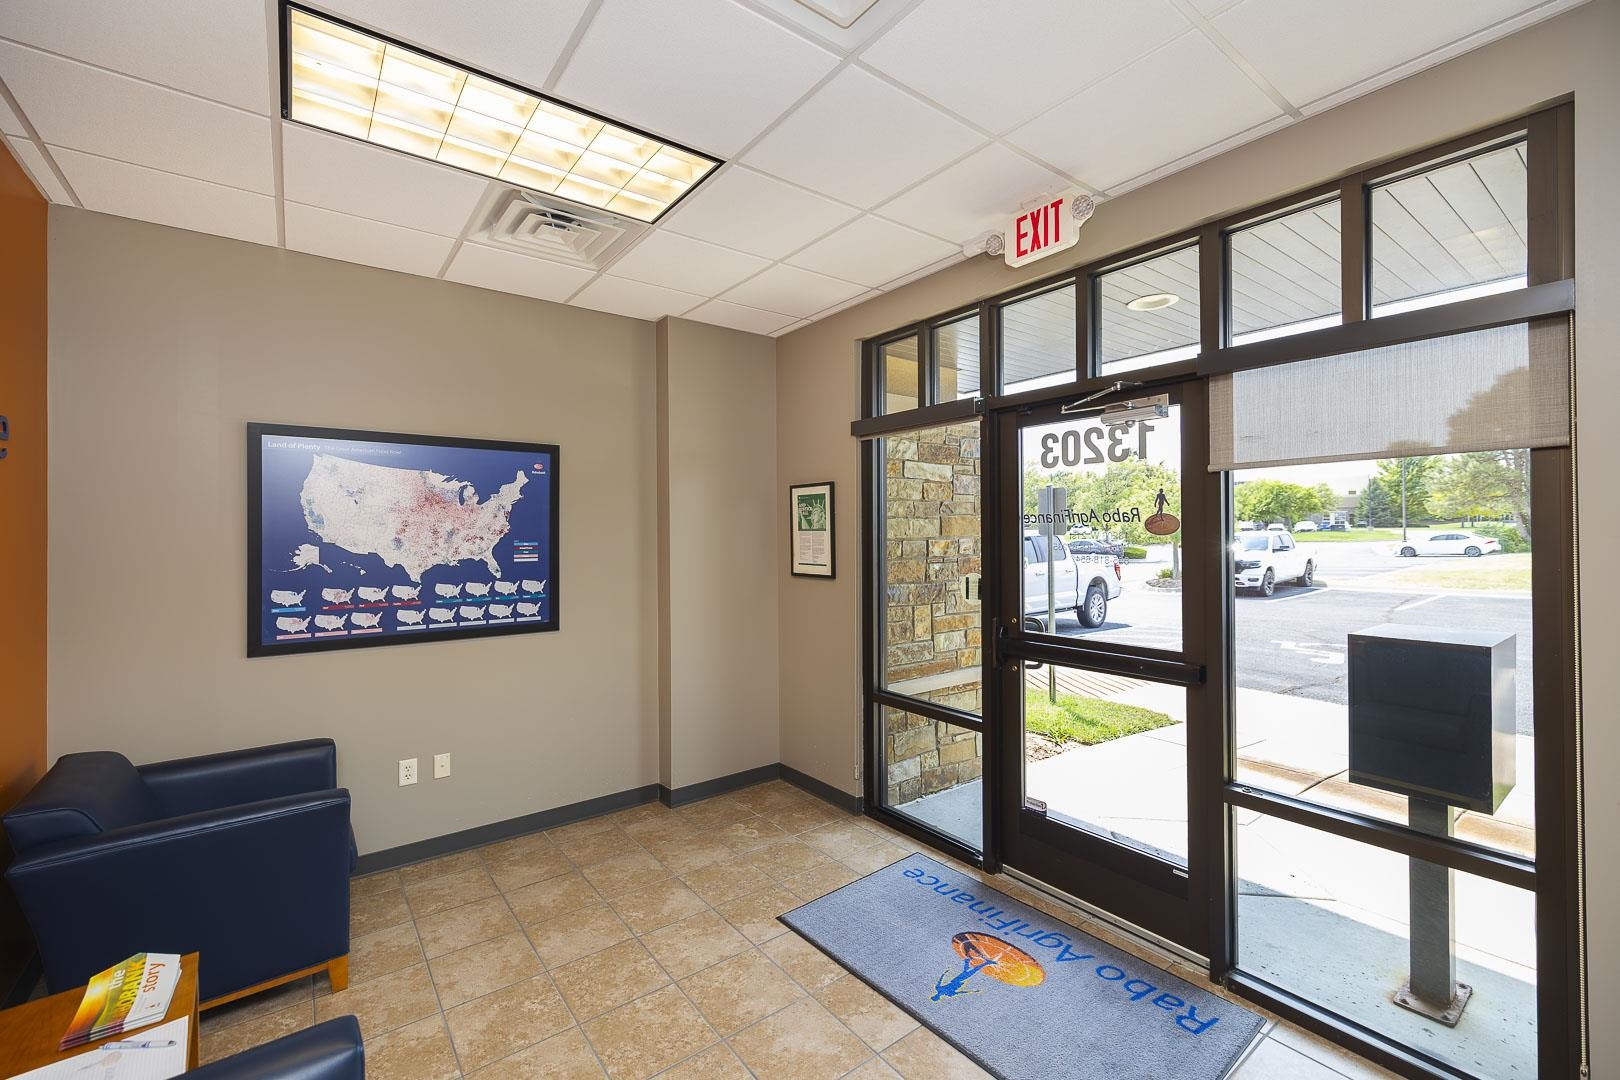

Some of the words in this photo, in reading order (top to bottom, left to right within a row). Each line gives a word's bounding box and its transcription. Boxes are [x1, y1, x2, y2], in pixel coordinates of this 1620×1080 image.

[1016, 198, 1063, 258] EXIT
[297, 442, 321, 451] Plenty
[903, 867, 1093, 962] AgriFinance
[108, 969, 126, 990] the
[142, 962, 166, 993] story
[1096, 964, 1219, 1035] Rabo
